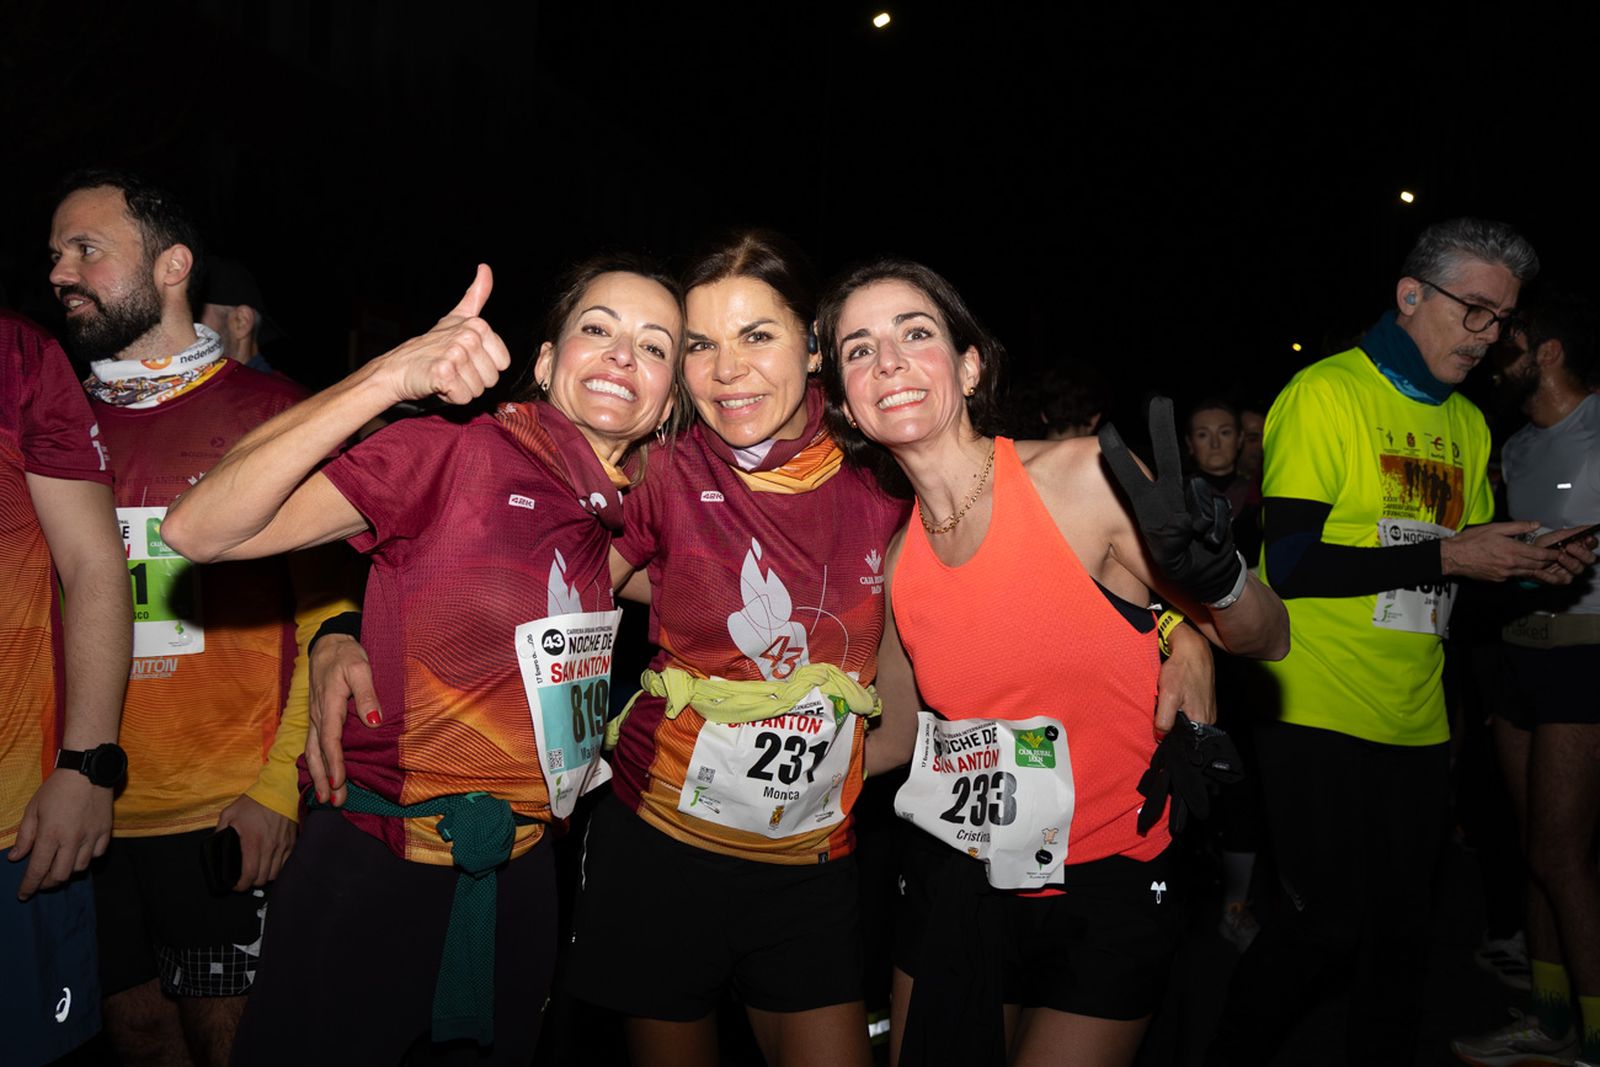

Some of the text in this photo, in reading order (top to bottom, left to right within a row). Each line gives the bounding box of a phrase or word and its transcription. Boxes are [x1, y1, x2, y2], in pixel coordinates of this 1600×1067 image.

[543, 634, 565, 651] 43
[569, 633, 613, 655] NOCHE DE
[759, 635, 804, 679] 43
[550, 660, 577, 683] SAN
[570, 679, 609, 744] 819
[981, 727, 998, 745] DE
[746, 731, 830, 785] 231
[933, 745, 1000, 774] SAN ANTÓN
[939, 771, 1017, 826] 233
